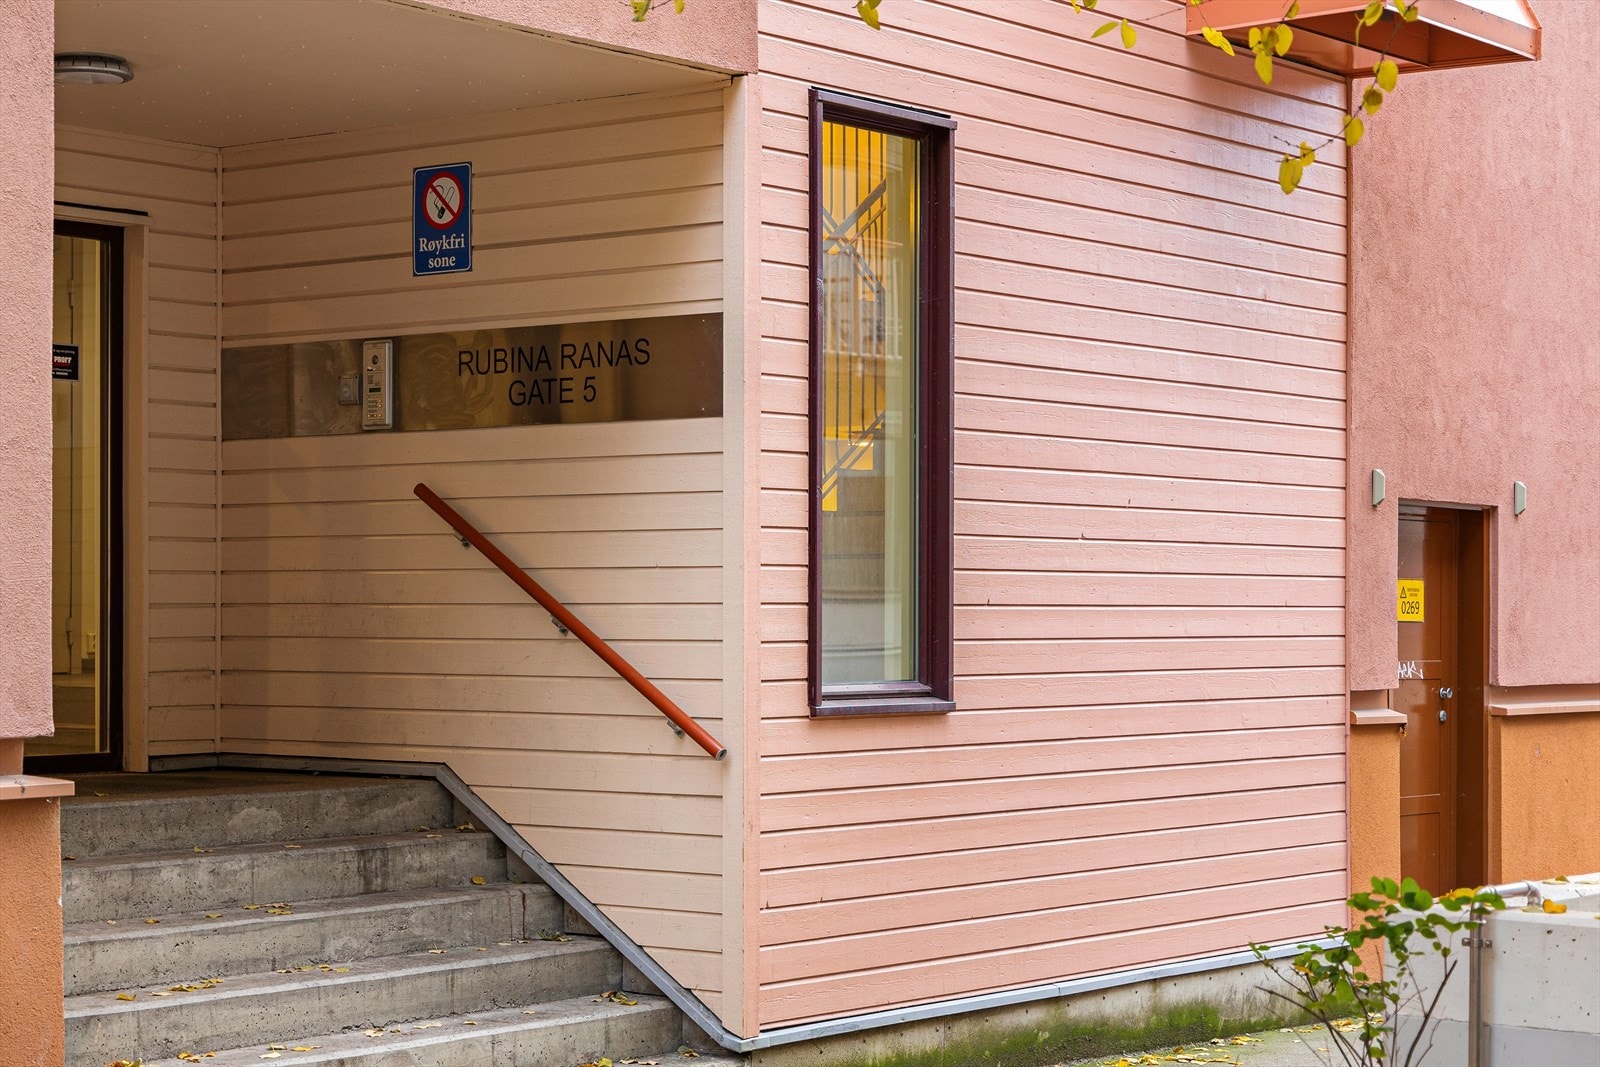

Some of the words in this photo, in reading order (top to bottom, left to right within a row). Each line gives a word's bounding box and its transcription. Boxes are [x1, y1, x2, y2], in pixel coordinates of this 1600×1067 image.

[419, 233, 465, 255] Røykfri
[428, 256, 456, 268] sone
[458, 345, 552, 376] RUBINA
[560, 338, 651, 369] RANAS
[508, 377, 574, 407] GATE
[583, 376, 597, 402] 5
[1401, 601, 1420, 614] 0269
